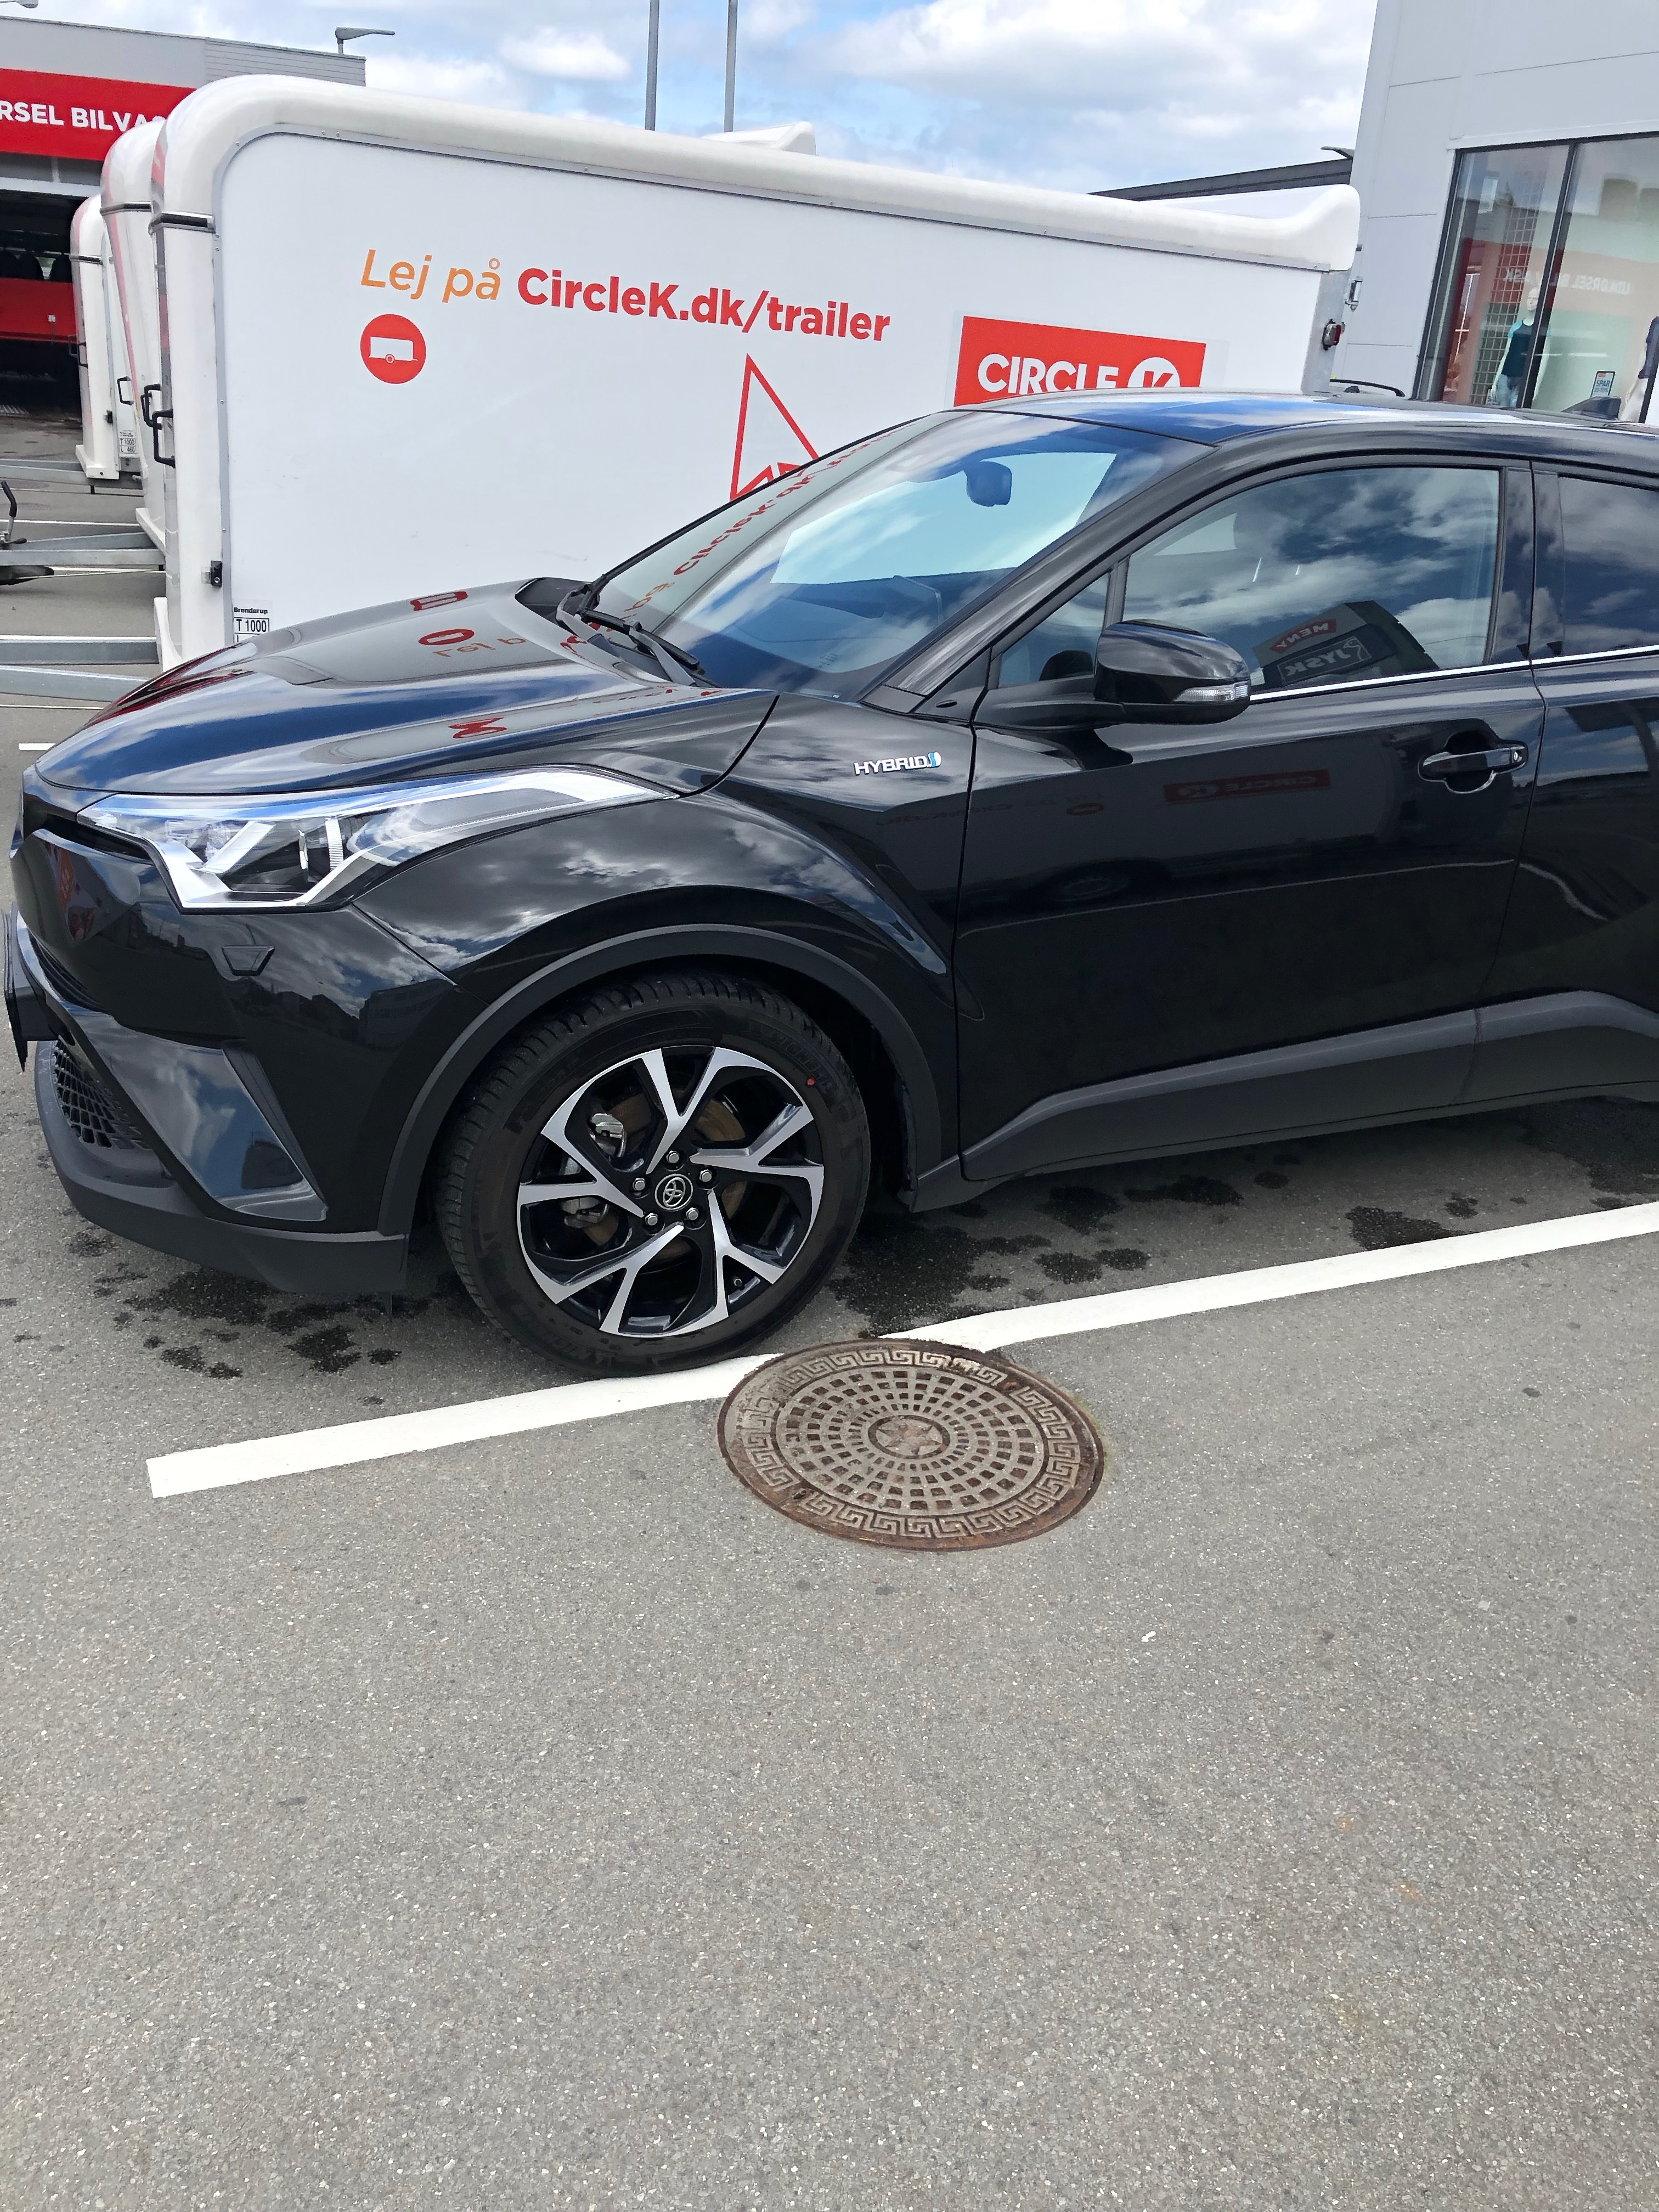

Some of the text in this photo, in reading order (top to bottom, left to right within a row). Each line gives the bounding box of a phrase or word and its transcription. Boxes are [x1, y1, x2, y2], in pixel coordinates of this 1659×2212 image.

[0, 100, 166, 132] RSEL BILVA
[360, 249, 891, 341] Lej på CircleK.dk/trailer
[236, 618, 267, 633] T 1000
[854, 755, 928, 775] HYBRID
